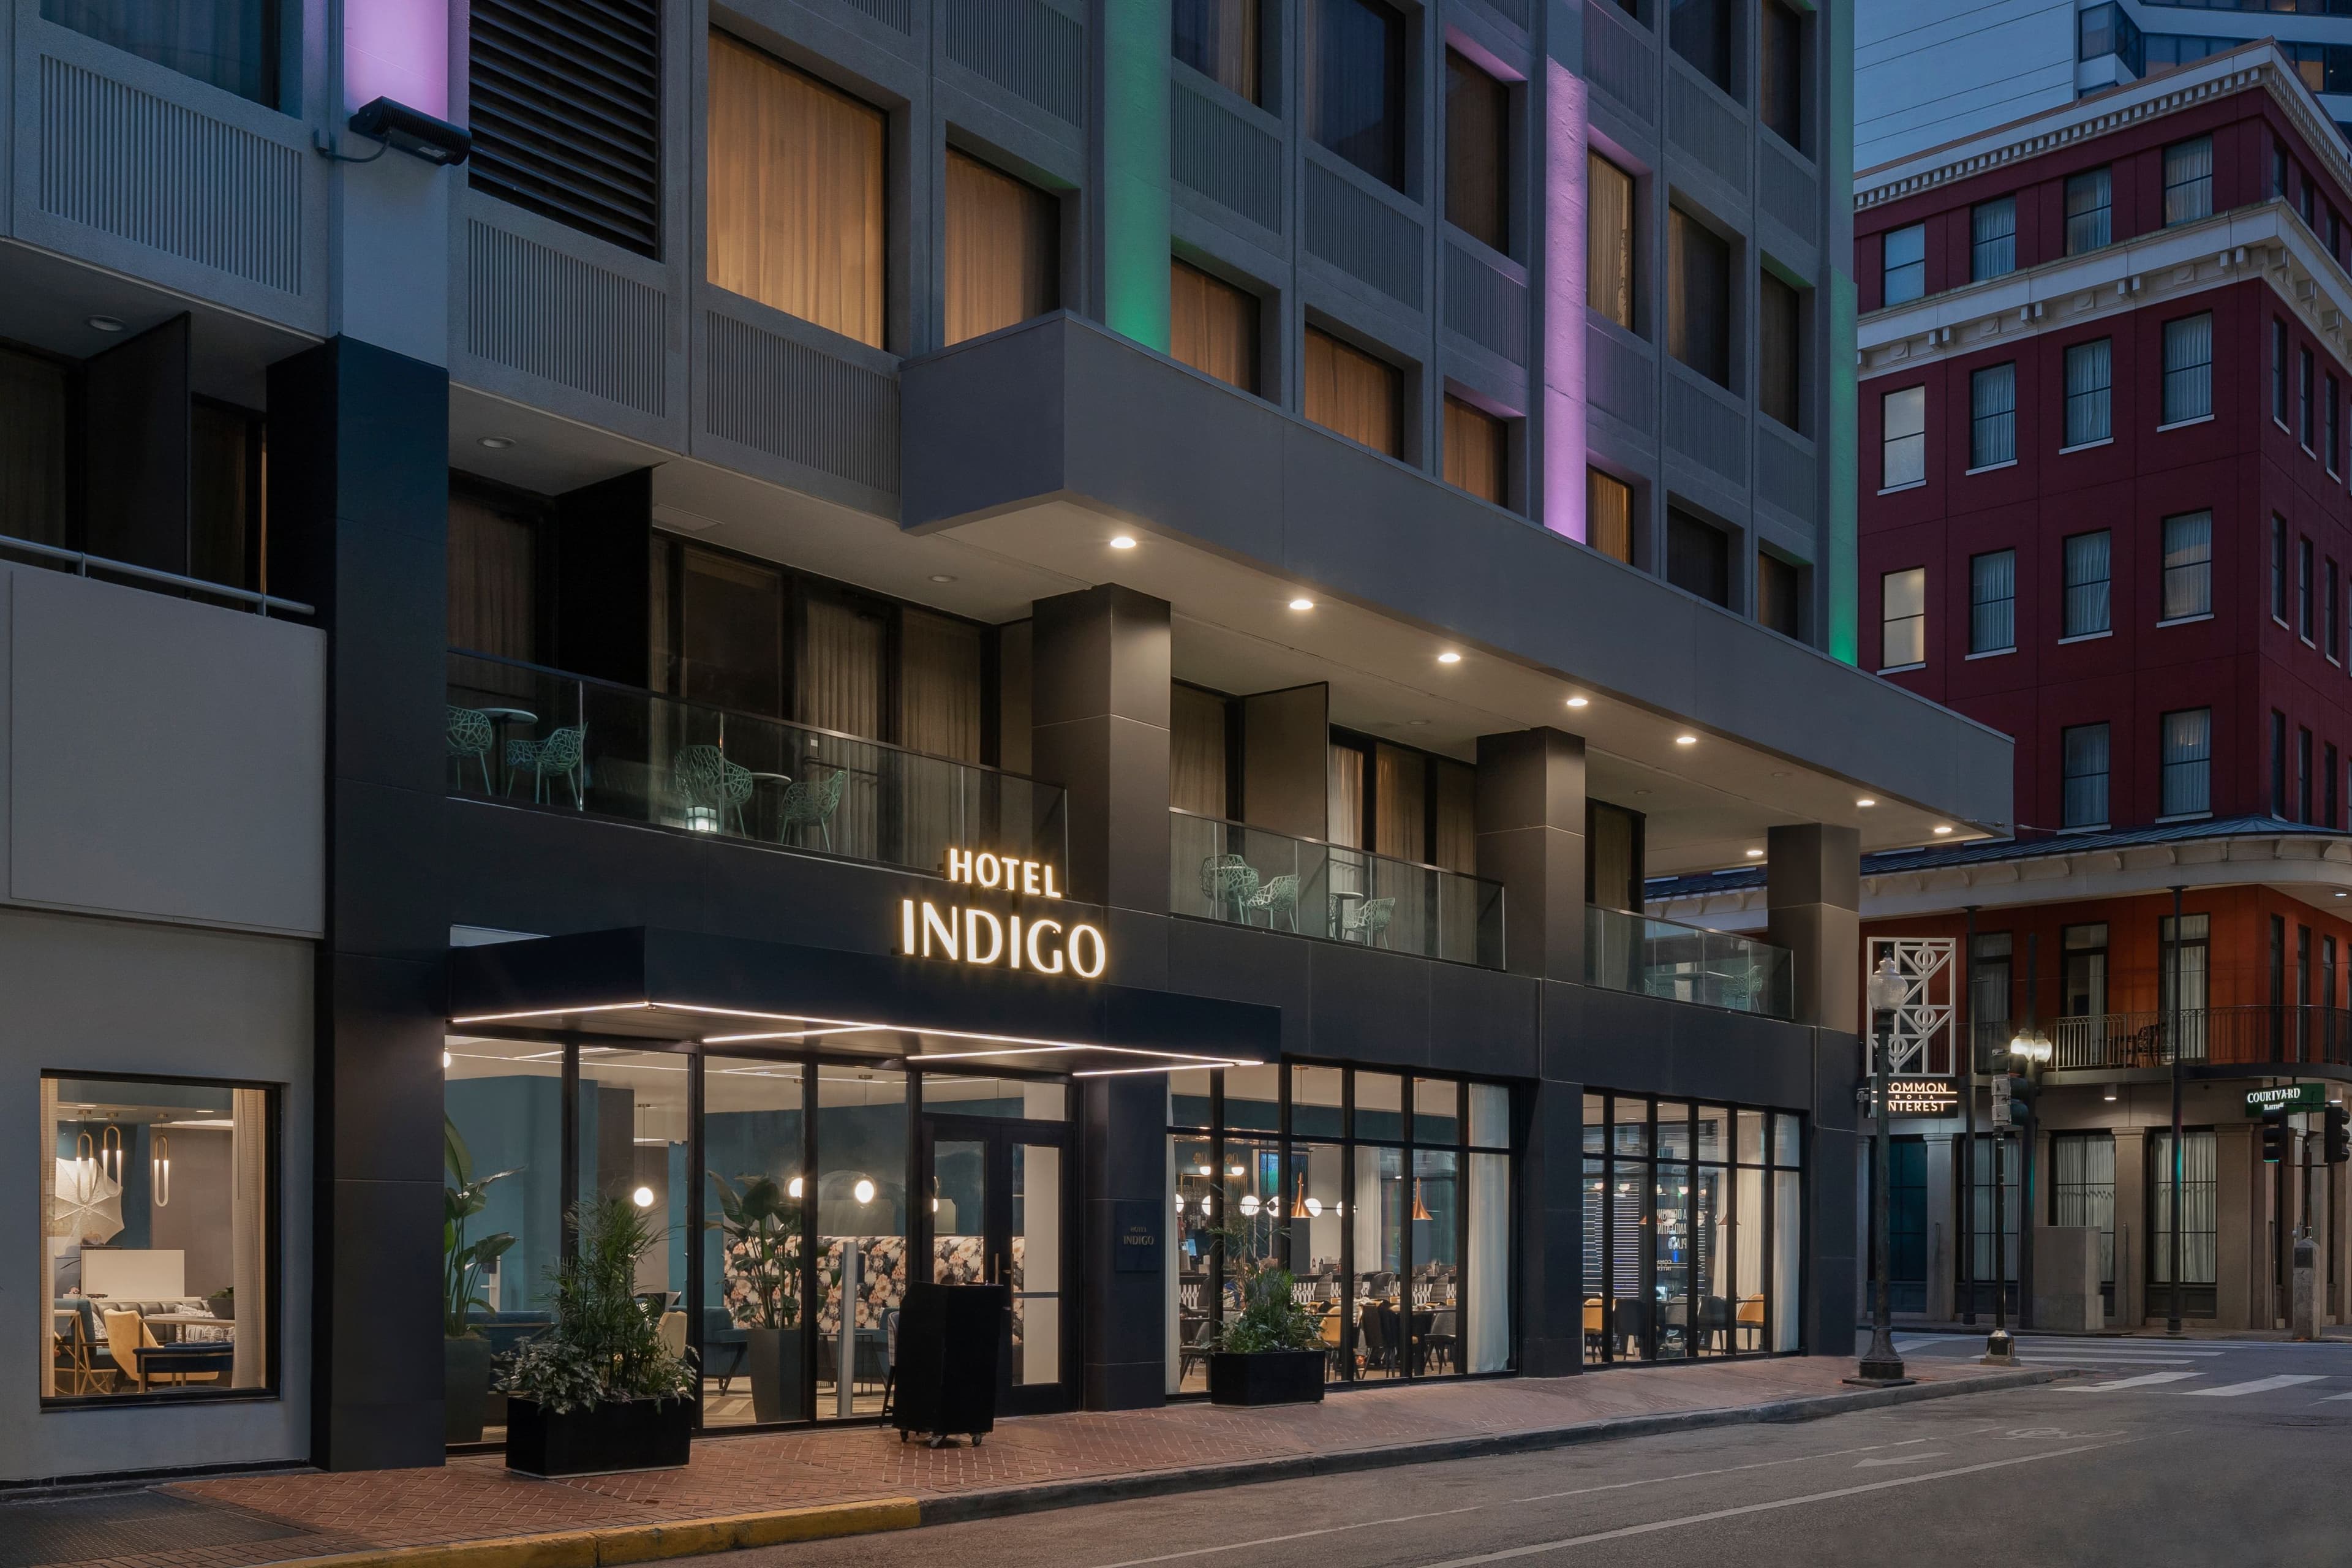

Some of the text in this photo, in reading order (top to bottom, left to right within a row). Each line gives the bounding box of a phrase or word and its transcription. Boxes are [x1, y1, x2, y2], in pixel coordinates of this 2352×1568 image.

[950, 848, 1061, 899] HOTEL
[903, 899, 1106, 979] INDIGO
[1888, 1082, 1947, 1092] OMMON
[2247, 1088, 2301, 1103] COURTYARD
[1888, 1101, 1944, 1112] NTEREST
[1123, 1235, 1154, 1245] INDIGO
